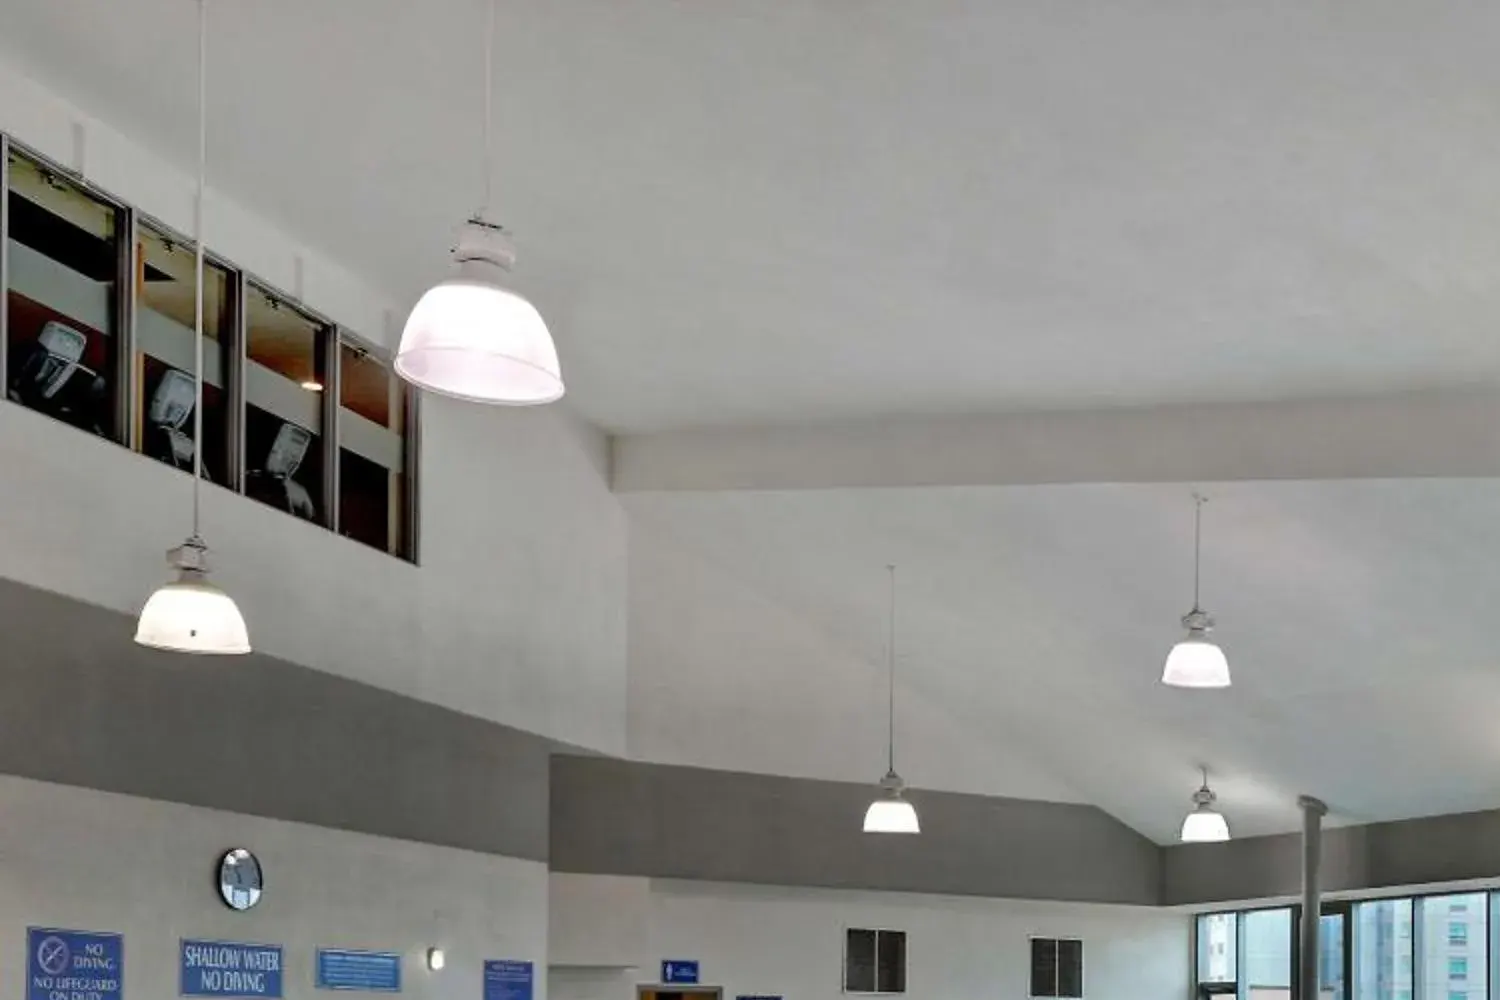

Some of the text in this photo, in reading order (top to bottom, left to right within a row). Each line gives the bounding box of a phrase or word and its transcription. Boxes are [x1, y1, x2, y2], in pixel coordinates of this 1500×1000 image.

[84, 943, 104, 956] NO
[185, 946, 279, 971] SHALLOW WATER
[34, 976, 53, 990] NO
[201, 969, 265, 993] NO DIVING
